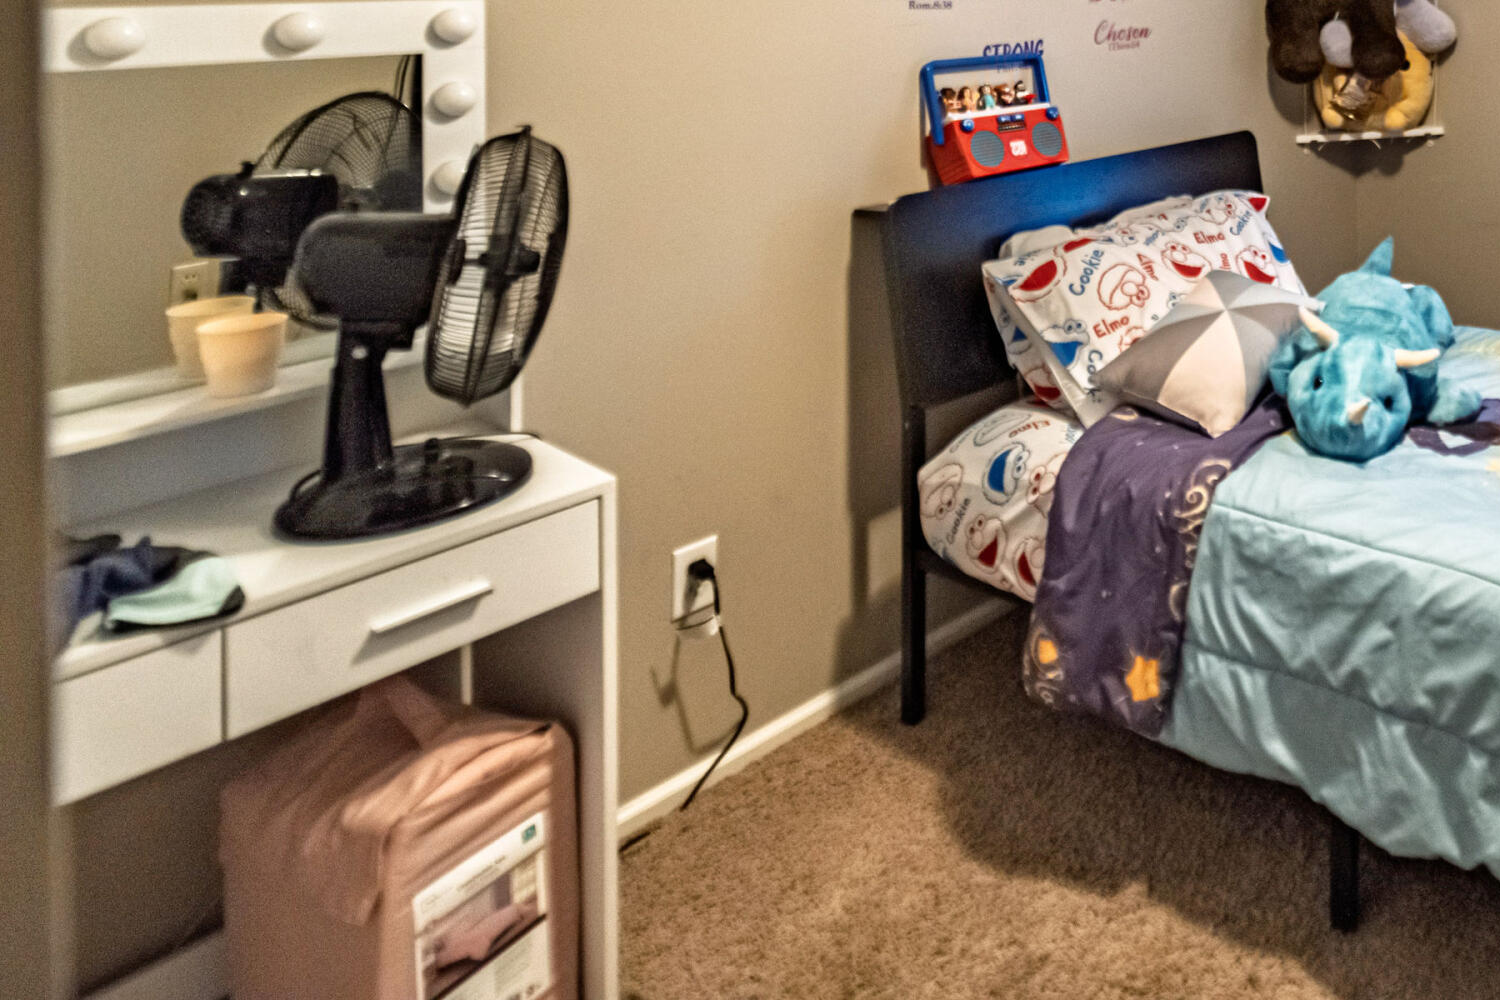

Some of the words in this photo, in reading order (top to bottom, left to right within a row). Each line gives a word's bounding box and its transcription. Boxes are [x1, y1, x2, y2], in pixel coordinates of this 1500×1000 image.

[1093, 19, 1152, 45] Chosen
[983, 39, 1044, 57] STRONG
[1193, 231, 1226, 244] Elmo
[1068, 249, 1105, 296] Cookie
[1092, 316, 1130, 338] Elmo
